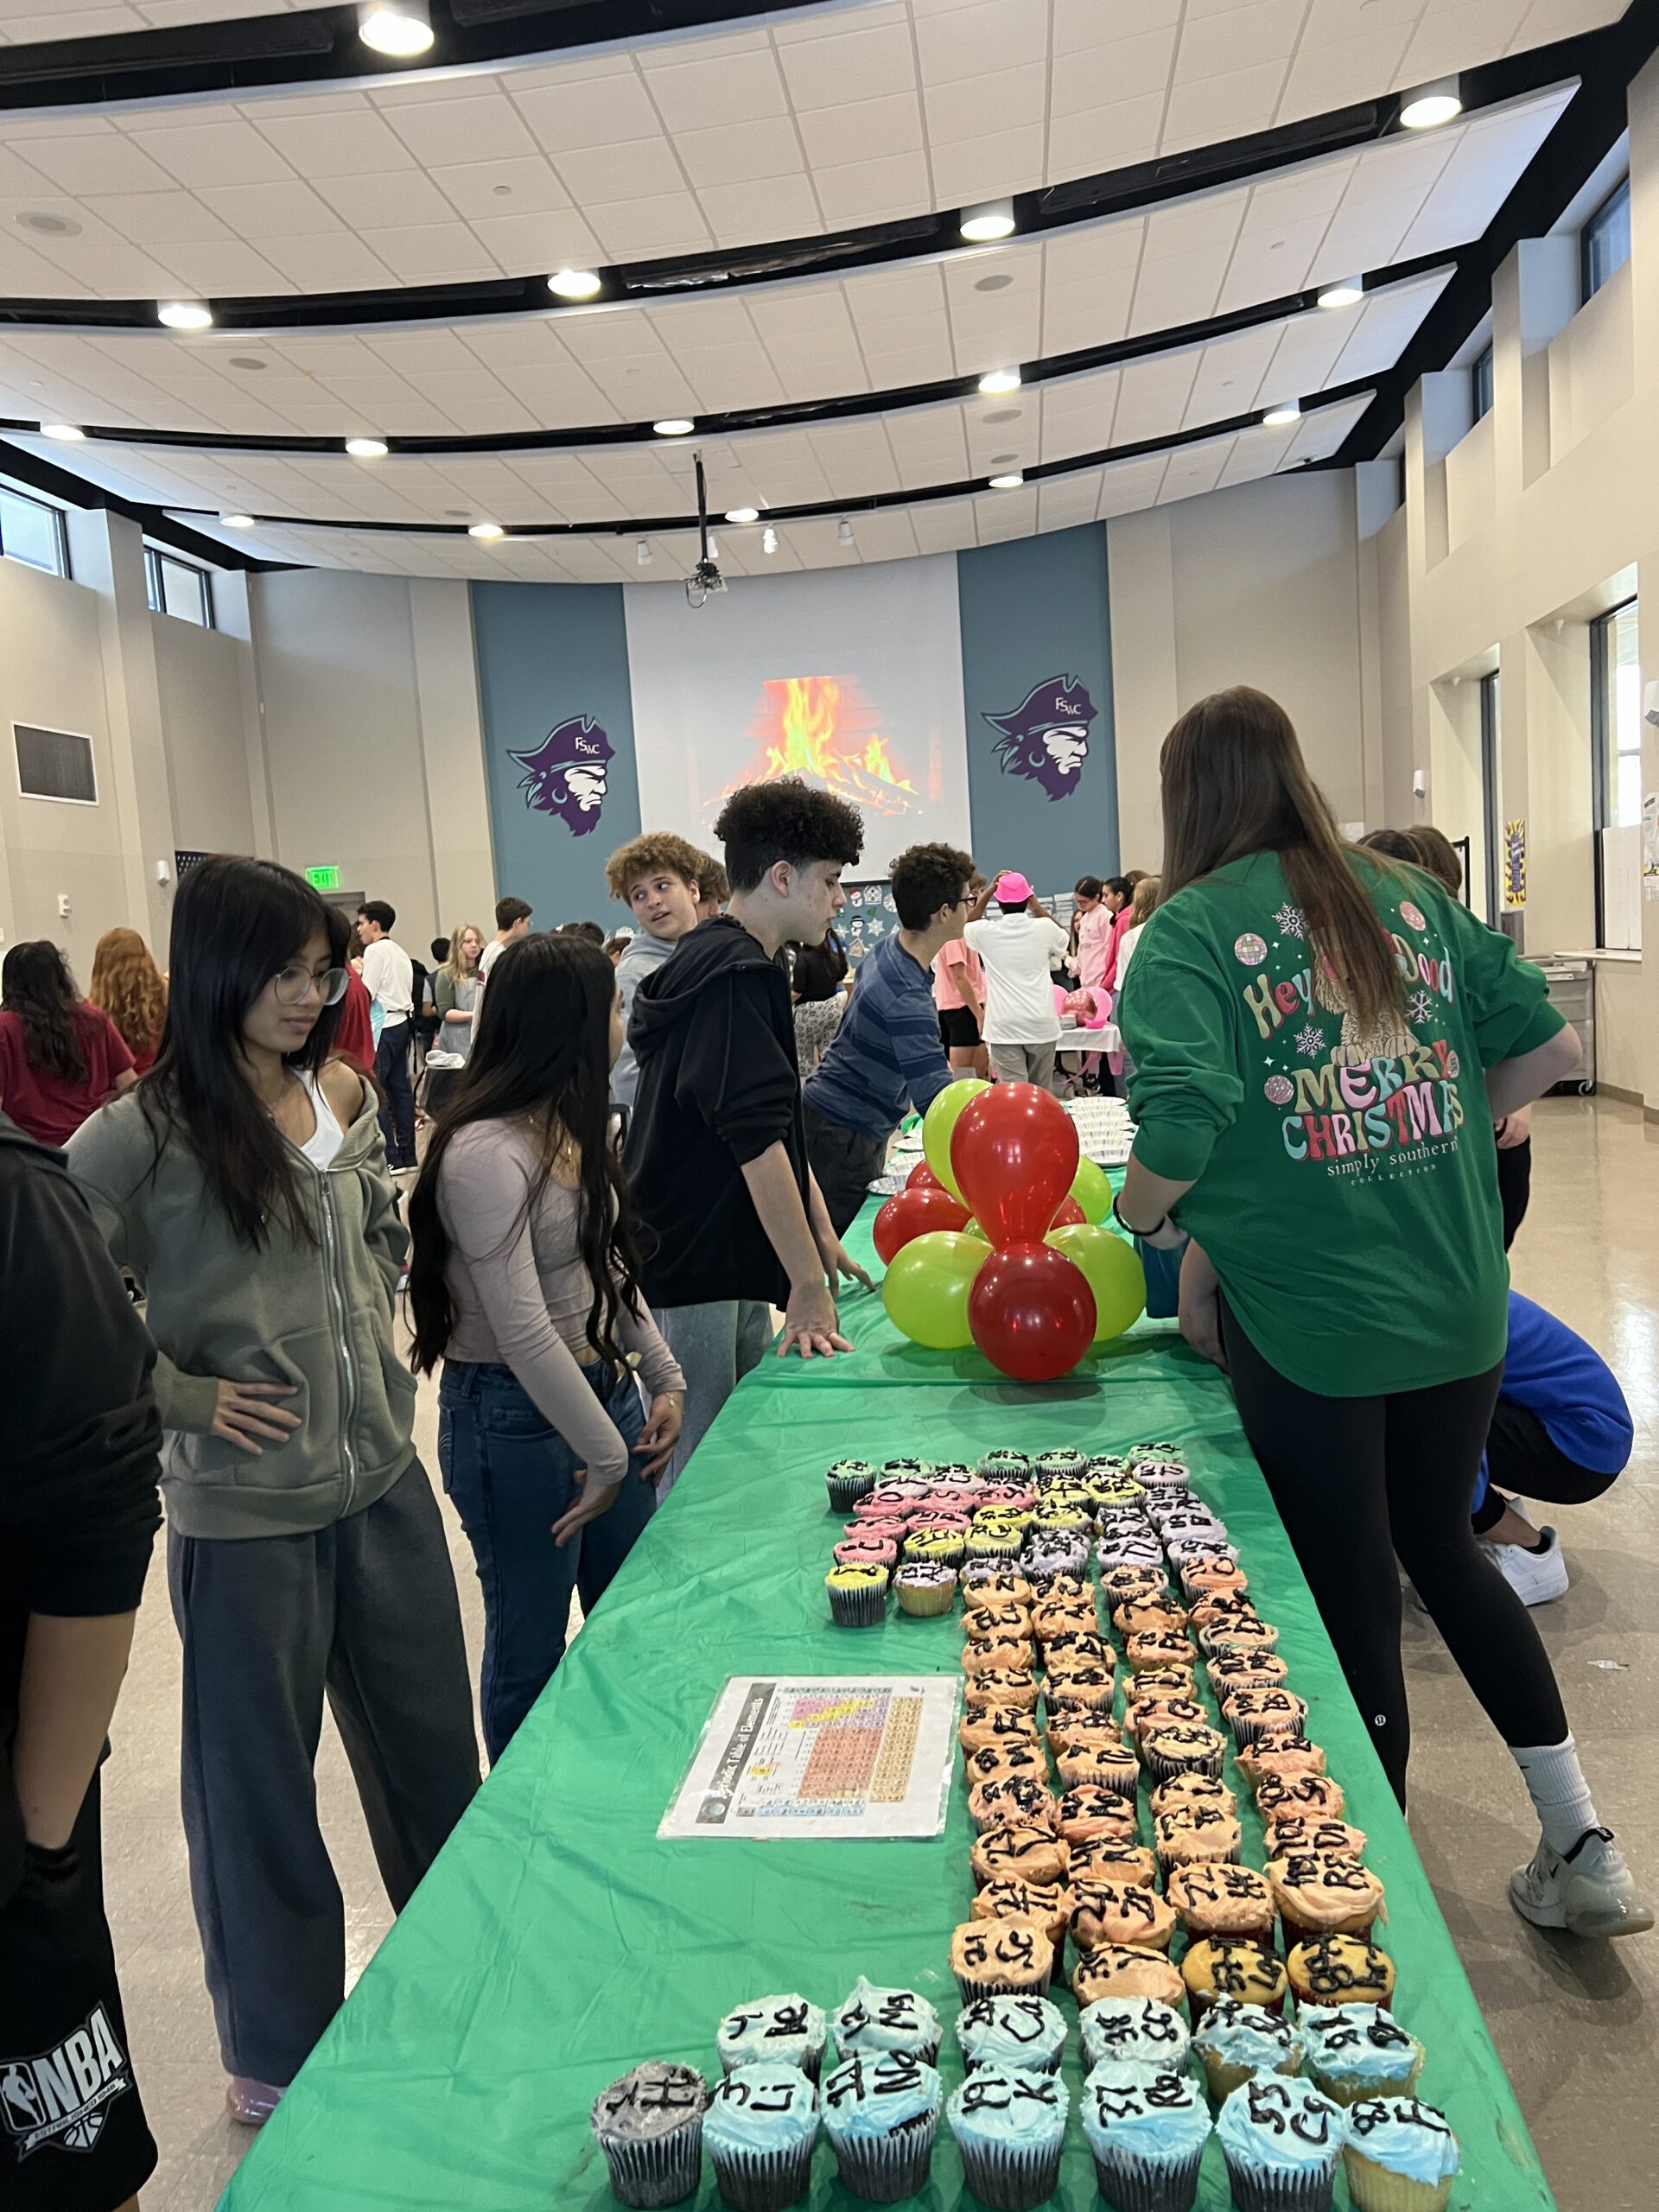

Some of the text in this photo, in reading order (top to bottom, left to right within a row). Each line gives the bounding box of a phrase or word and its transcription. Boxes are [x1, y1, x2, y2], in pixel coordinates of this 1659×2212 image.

[575, 736, 601, 754] FSWC
[310, 871, 333, 888] EXIT
[1243, 968, 1313, 1039] Hey
[1291, 1039, 1450, 1114] MERRY
[1282, 1079, 1465, 1161] CHRISTMAS
[1327, 1139, 1458, 1176] simply southern
[1350, 1163, 1436, 1185] COLLECTION
[740, 1697, 765, 1733] Elements
[726, 1743, 747, 1764] Table
[738, 1733, 751, 1744] of
[963, 1934, 987, 1967] 21
[995, 1930, 1034, 1971] Sc
[999, 1996, 1045, 2044] Ca
[31, 2007, 124, 2121] NBA
[749, 2082, 797, 2112] Li
[960, 2078, 1010, 2115] 19
[1012, 2078, 1058, 2106] K
[1095, 2084, 1143, 2129] 37
[1142, 2074, 1193, 2108] Rb
[1248, 2080, 1292, 2135] 55
